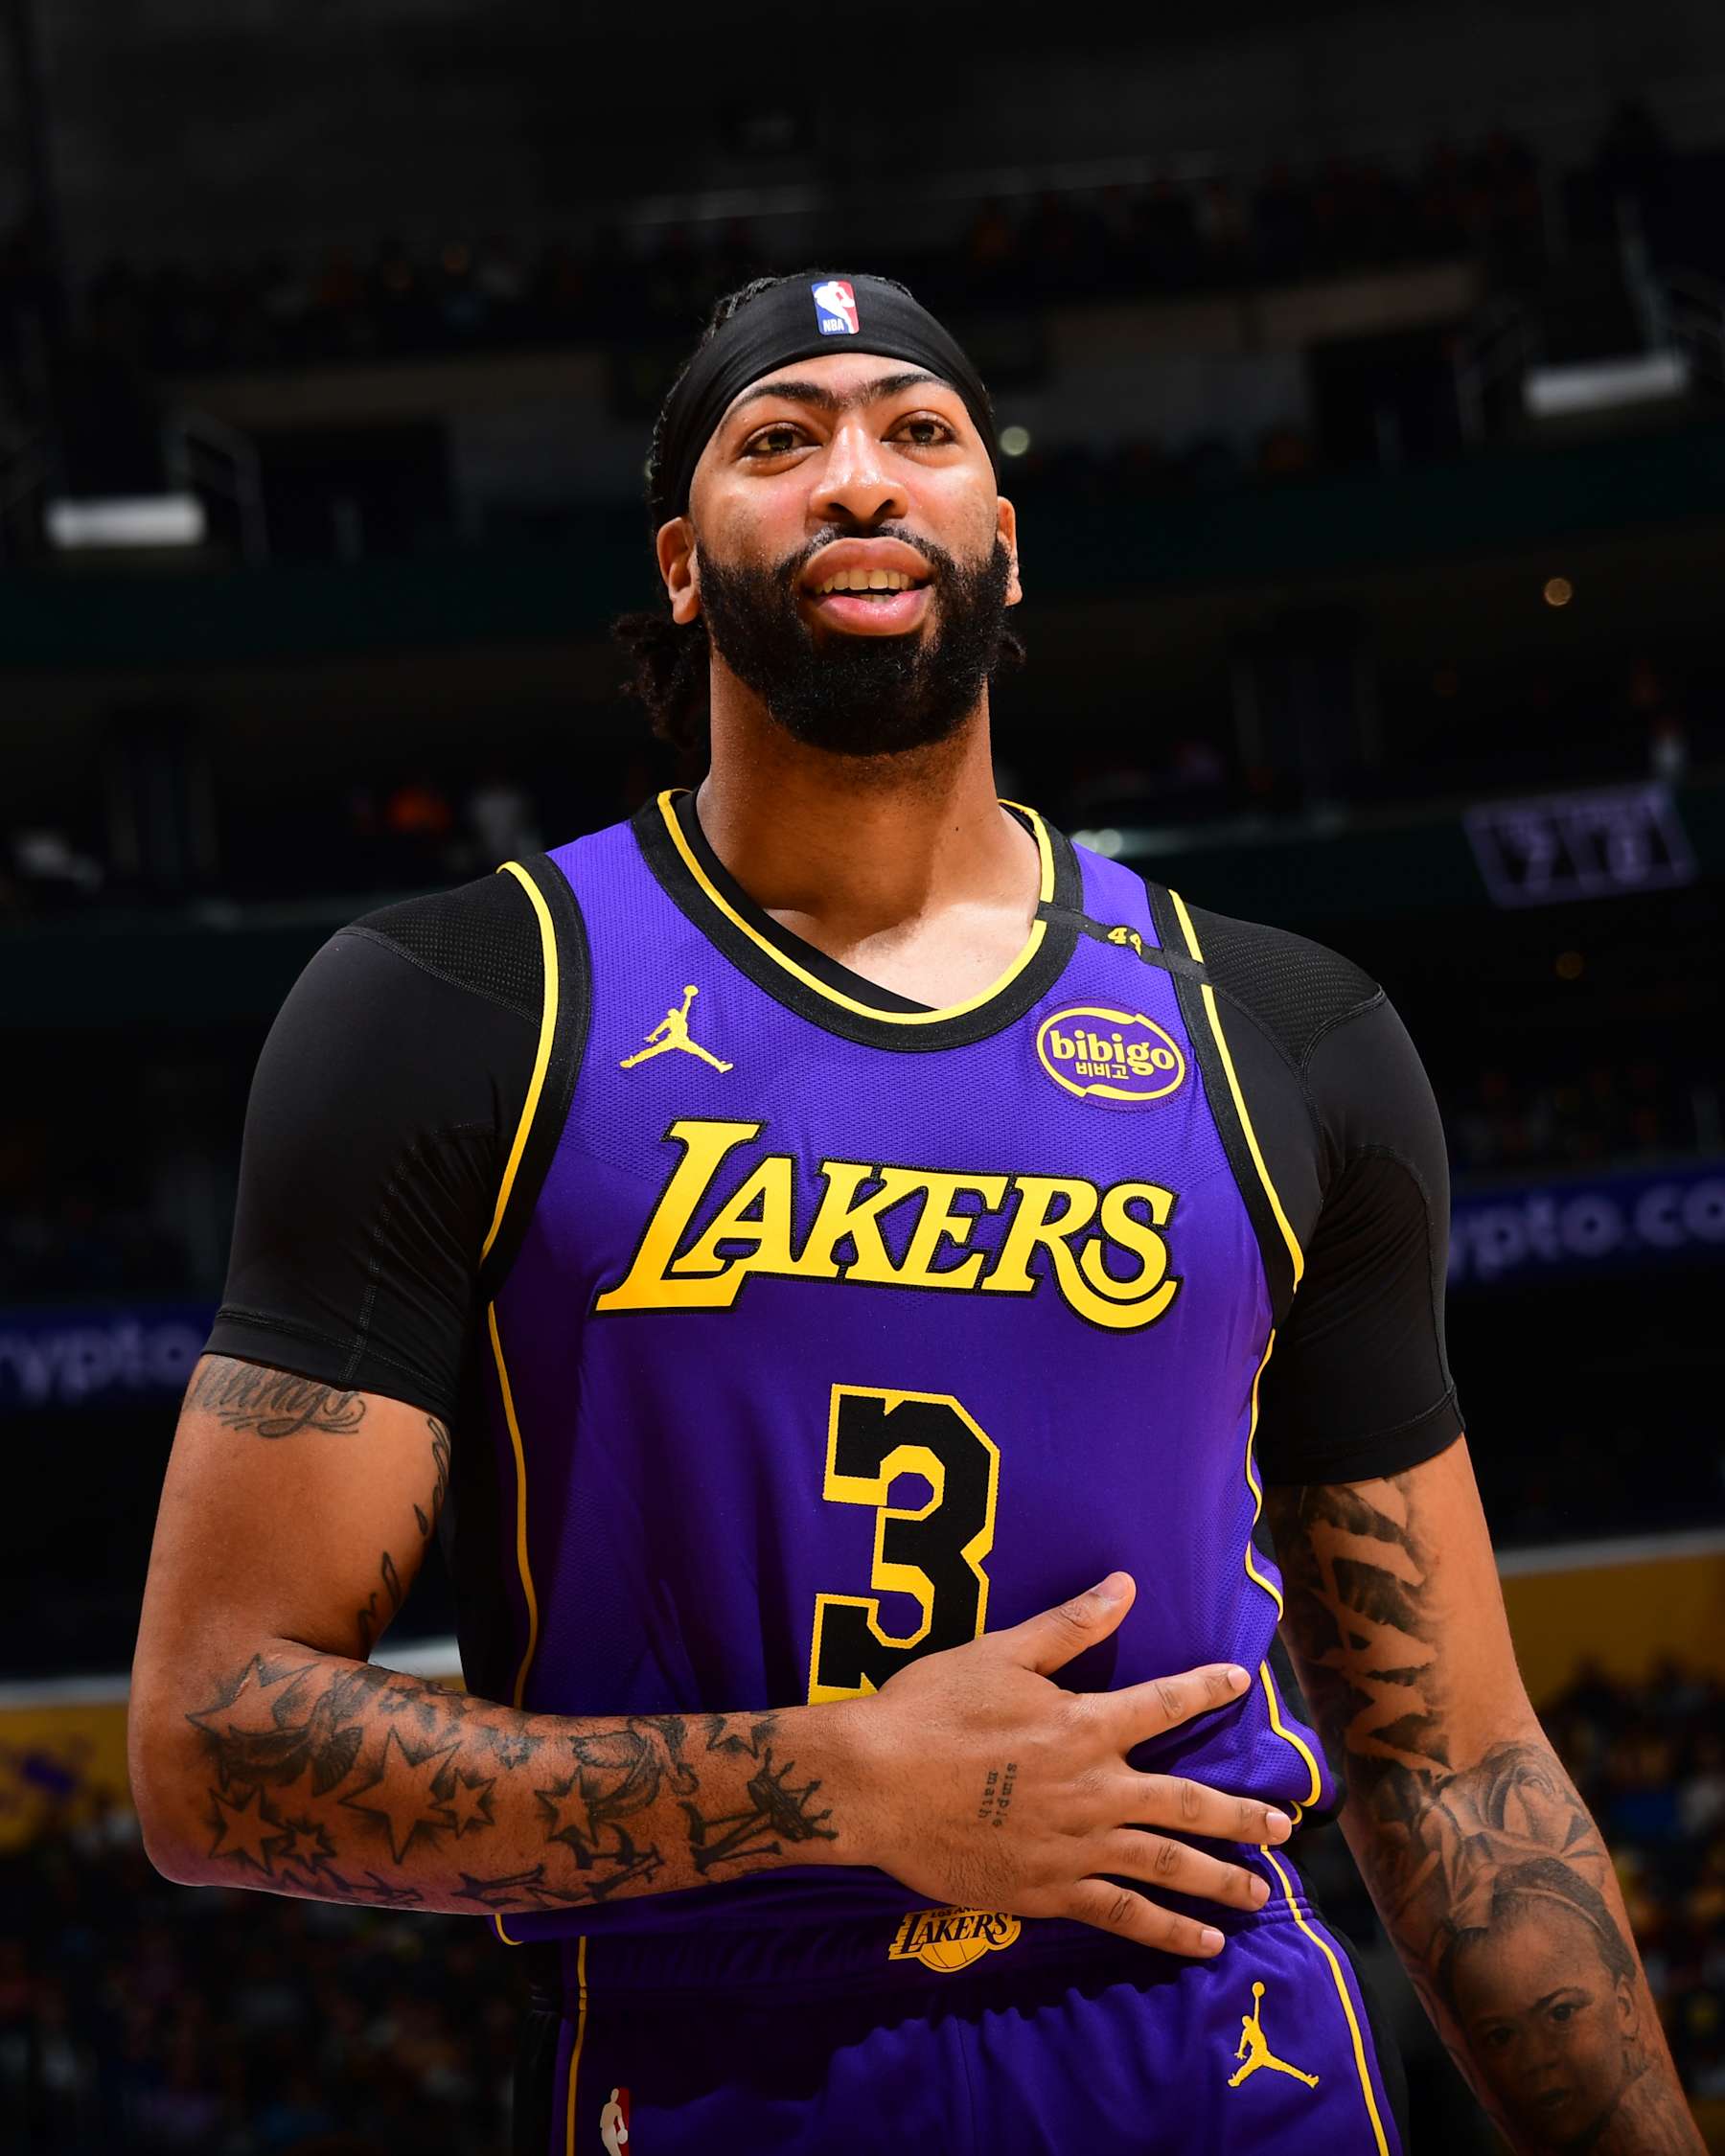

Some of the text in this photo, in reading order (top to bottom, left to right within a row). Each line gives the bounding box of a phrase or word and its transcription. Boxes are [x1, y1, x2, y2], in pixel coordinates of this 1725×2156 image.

[822, 318, 845, 333] NBA
[1049, 1029, 1176, 1076] bibigo
[1074, 1061, 1130, 1080] 비비고
[594, 1118, 1180, 1330] LAKERS
[808, 1384, 1000, 1706] 3
[897, 1912, 1016, 1955] LAKERS
